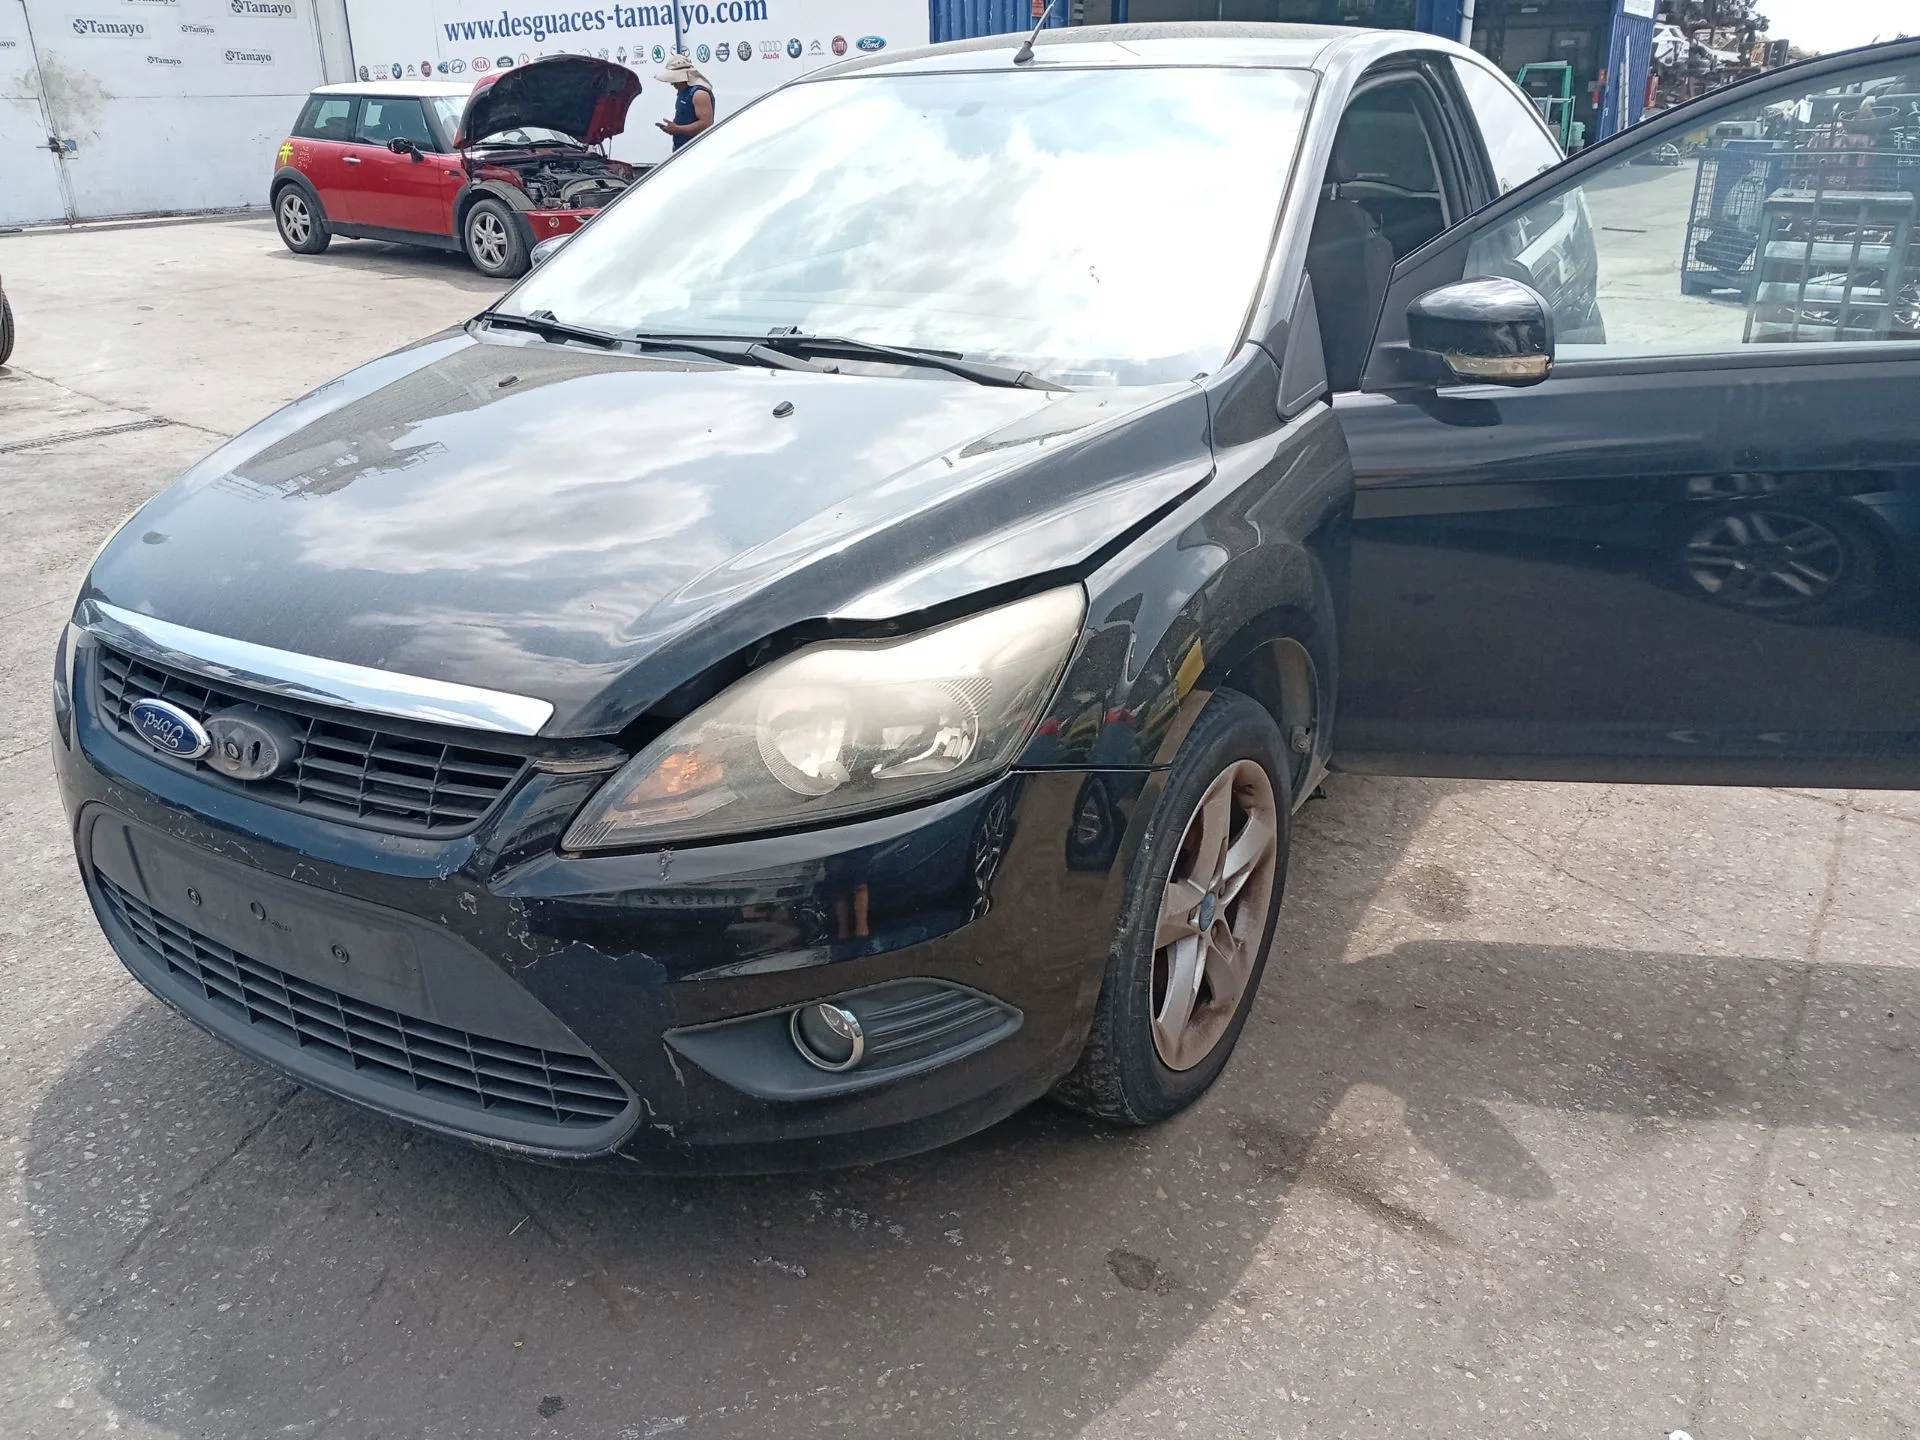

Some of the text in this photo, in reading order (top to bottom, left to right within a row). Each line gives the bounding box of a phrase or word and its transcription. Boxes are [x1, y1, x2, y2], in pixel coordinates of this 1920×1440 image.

[243, 1, 292, 16] Tamayo
[444, 0, 768, 42] www.desguaces-tamayo.com
[86, 20, 144, 37] Tamayo
[188, 25, 215, 34] Tamayo
[154, 56, 182, 65] Tamayo
[235, 51, 272, 63] Tamayo
